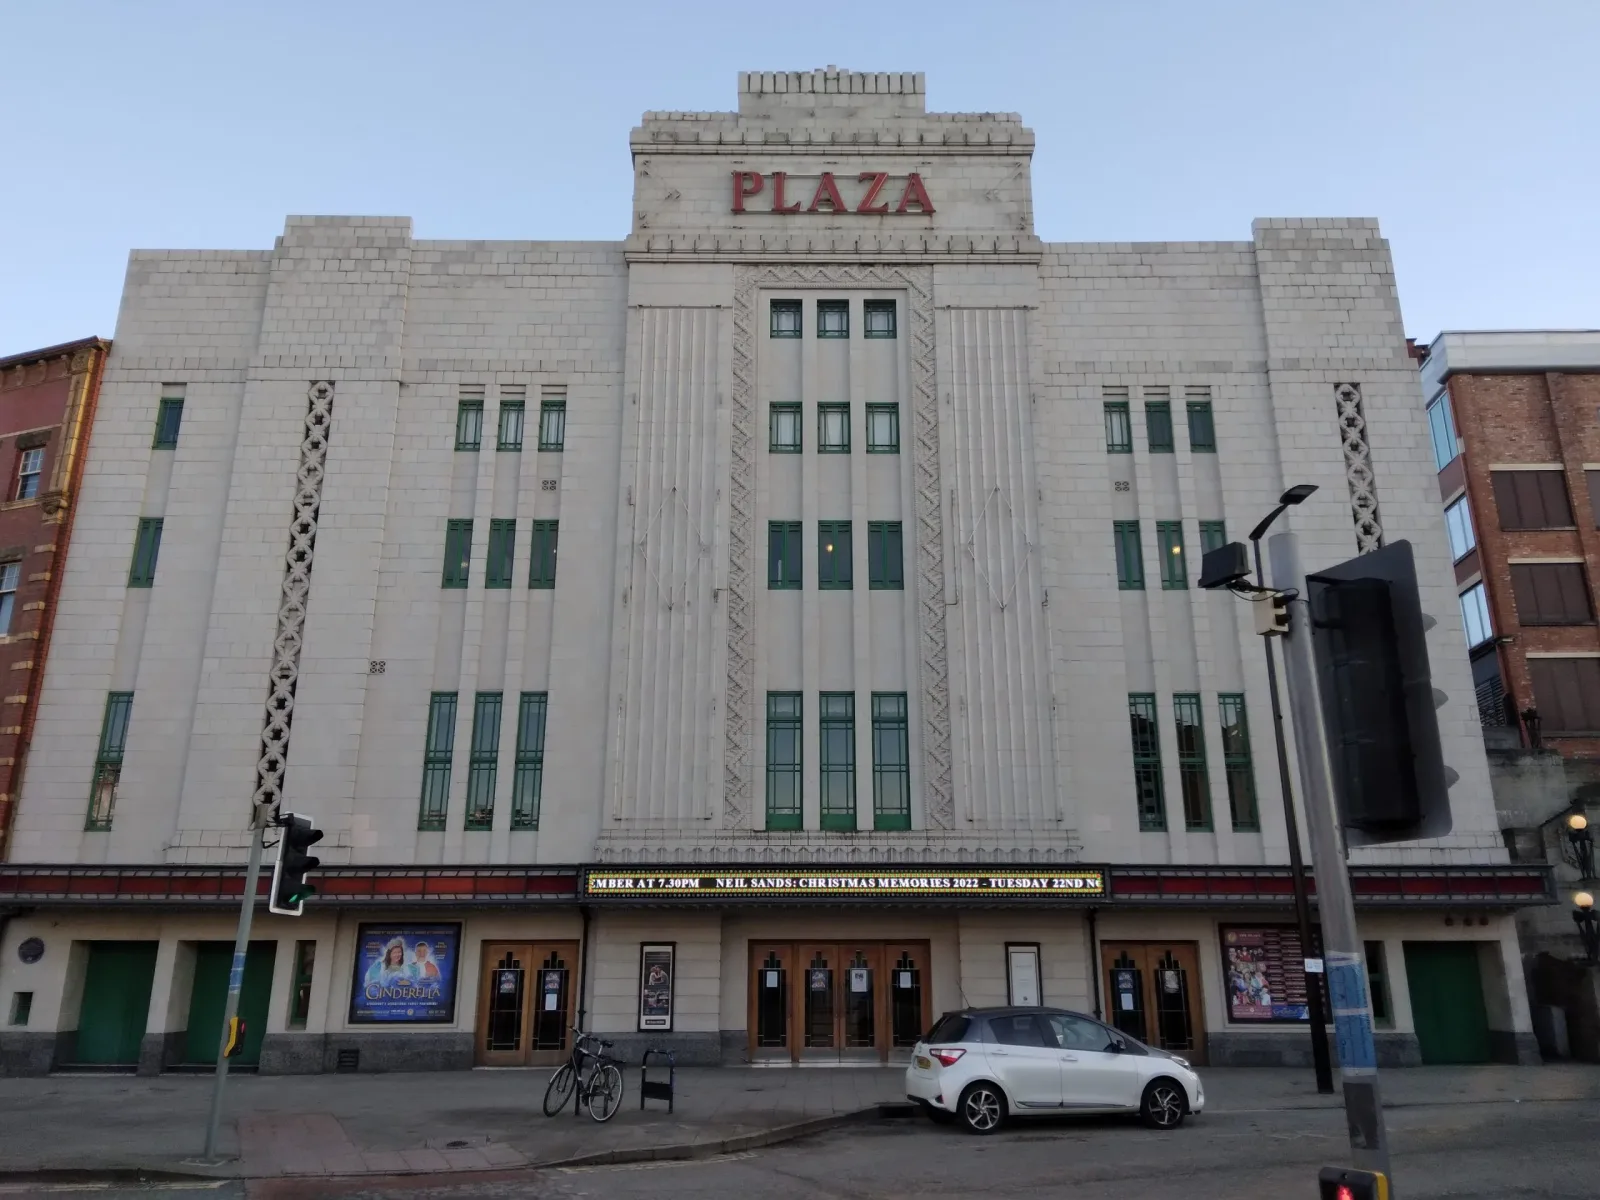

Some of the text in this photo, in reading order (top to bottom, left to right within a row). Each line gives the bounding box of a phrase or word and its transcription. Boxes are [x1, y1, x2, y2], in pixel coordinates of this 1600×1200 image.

[731, 171, 936, 213] PLAZA
[637, 878, 655, 888] AT
[659, 878, 699, 888] 7.30PM
[716, 878, 747, 888] NEIL
[751, 878, 796, 888] SANDS:
[800, 878, 875, 888] CHRISTMAS
[878, 878, 951, 888] MEMORIES
[953, 878, 979, 888] 2022
[989, 878, 1049, 888] TUESDAY
[1052, 878, 1083, 888] 22ND
